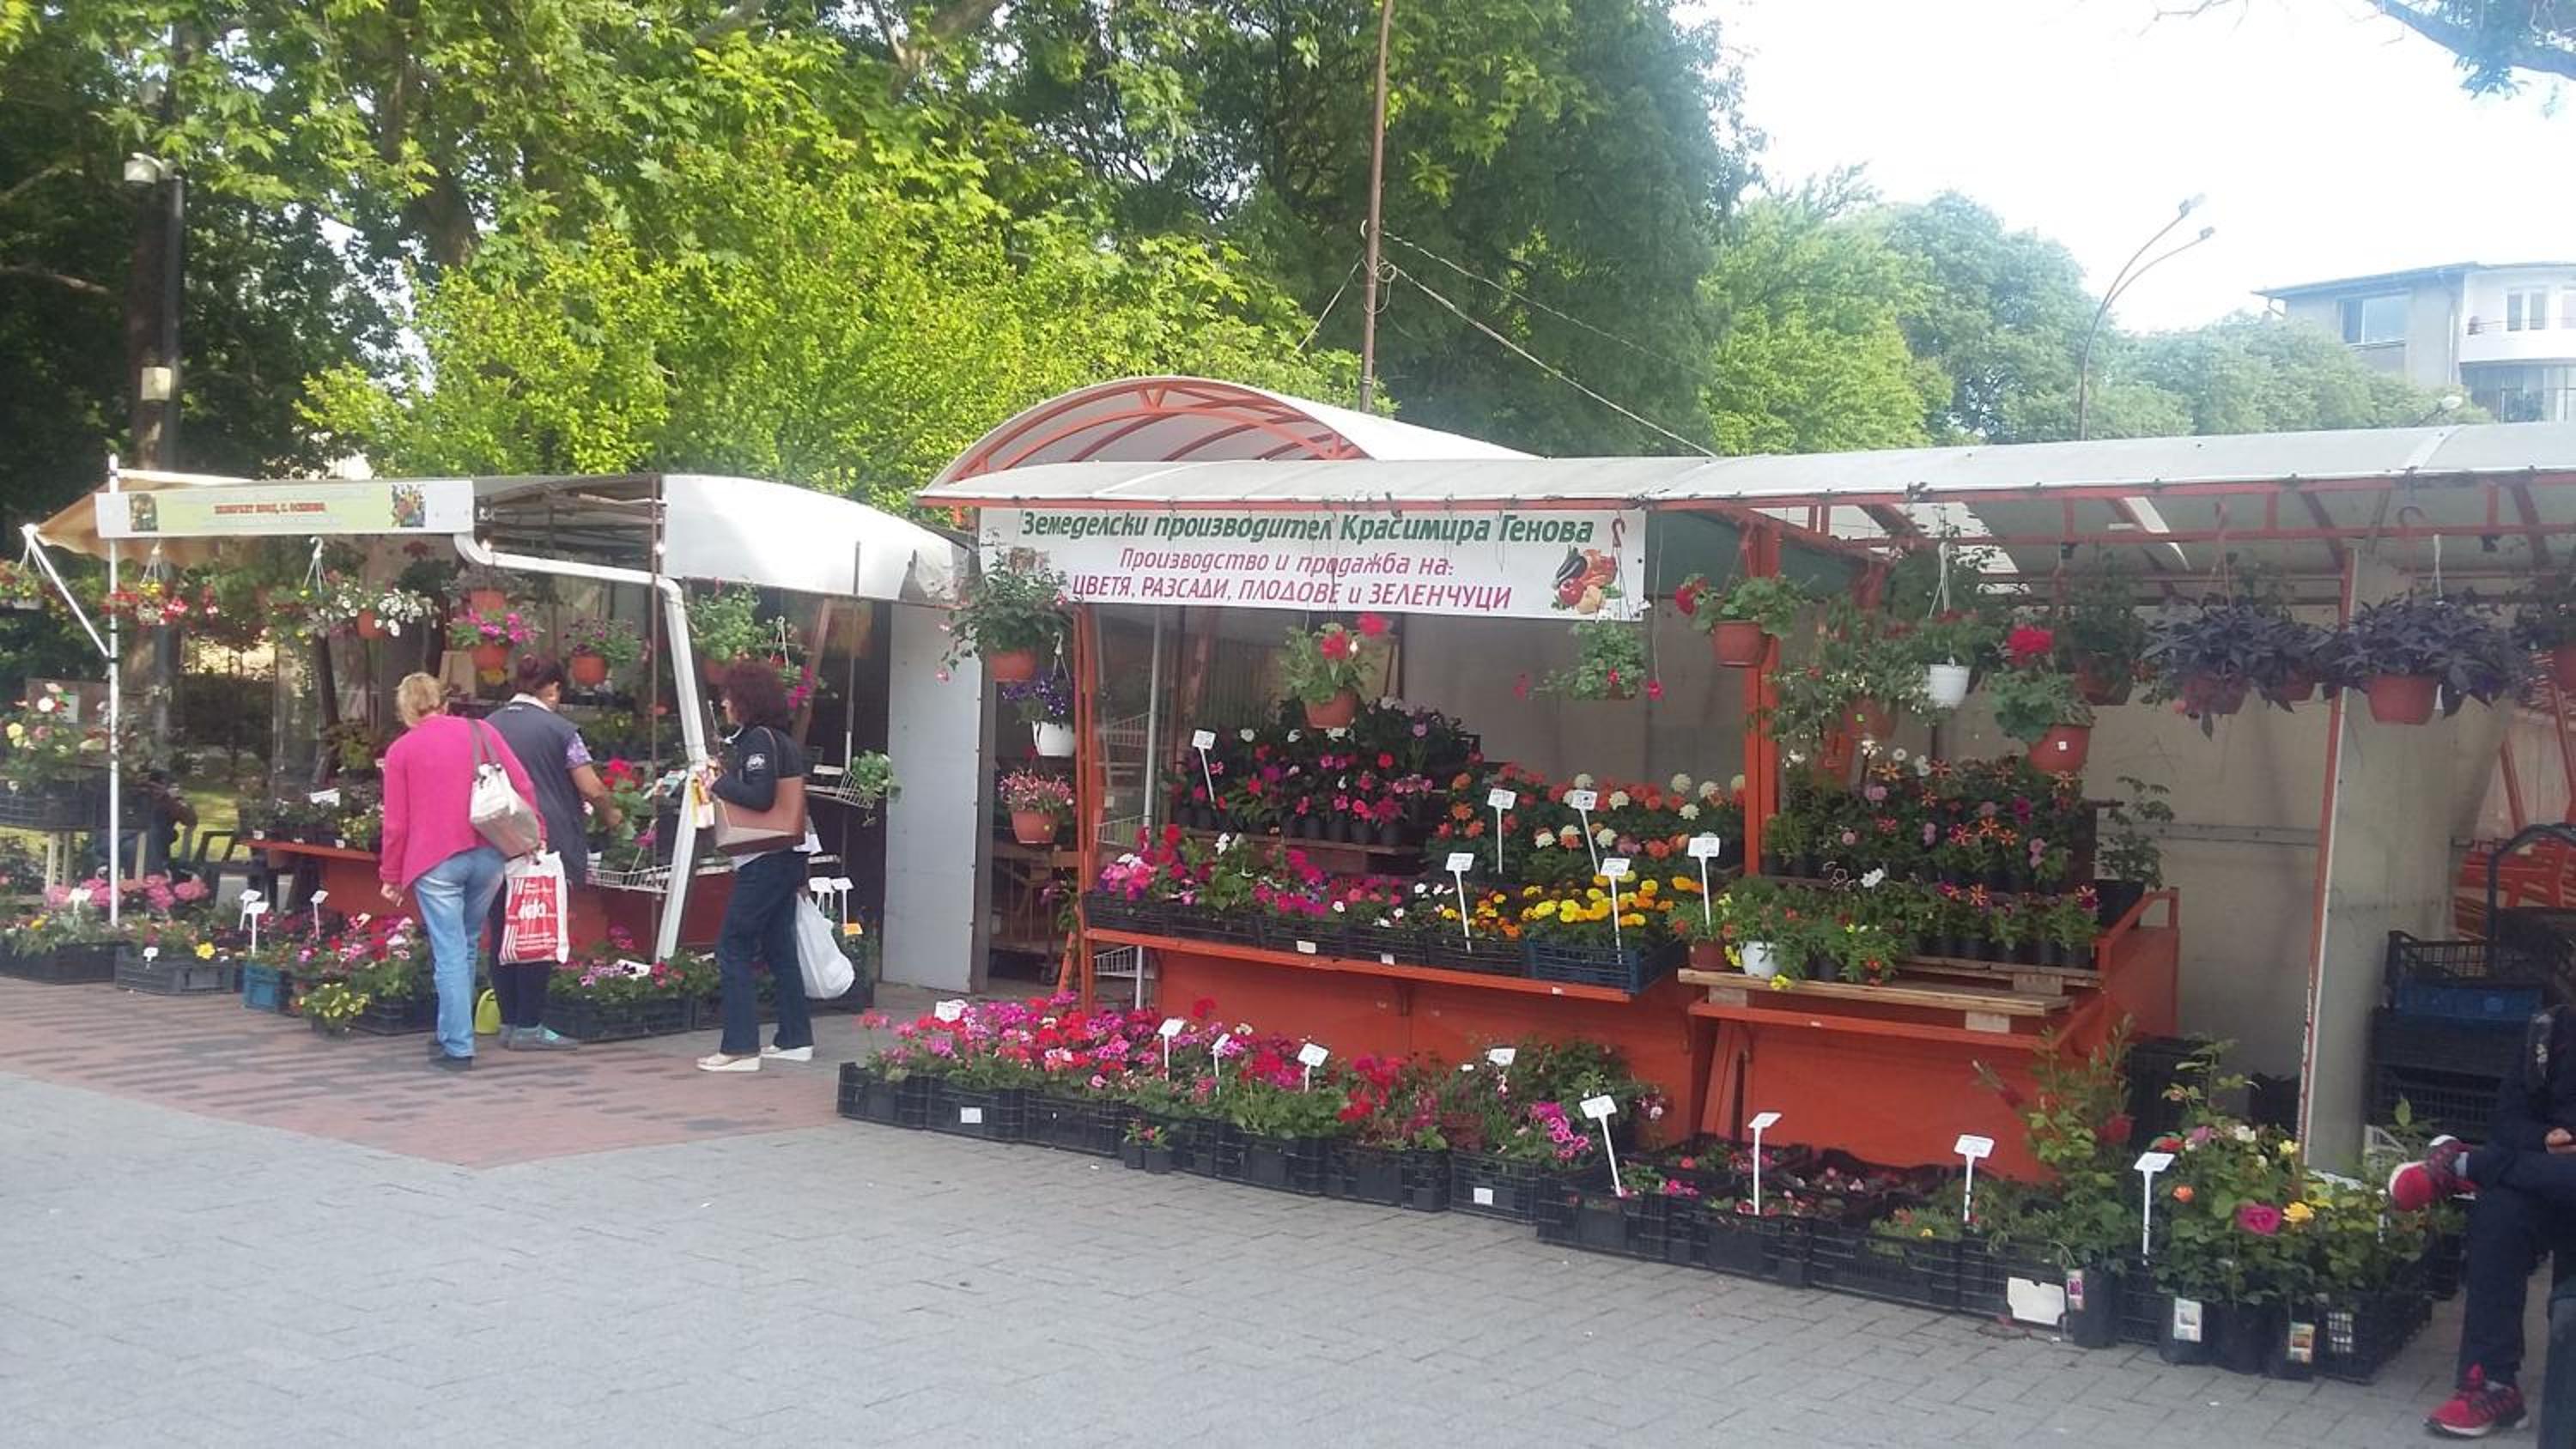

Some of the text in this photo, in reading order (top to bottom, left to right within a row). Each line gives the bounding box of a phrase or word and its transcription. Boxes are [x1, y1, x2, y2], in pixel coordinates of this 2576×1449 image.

[1021, 512, 1594, 545] Земеделски производител Красимира Генова
[1120, 548, 1454, 578] Производство и продажба на:
[1141, 577, 1232, 601] РАЗСАДИ,
[1238, 579, 1342, 604] ПЛОДОВЕ
[1348, 588, 1362, 604] и
[1369, 584, 1512, 612] ЗЕЛЕНЧУЦИ
